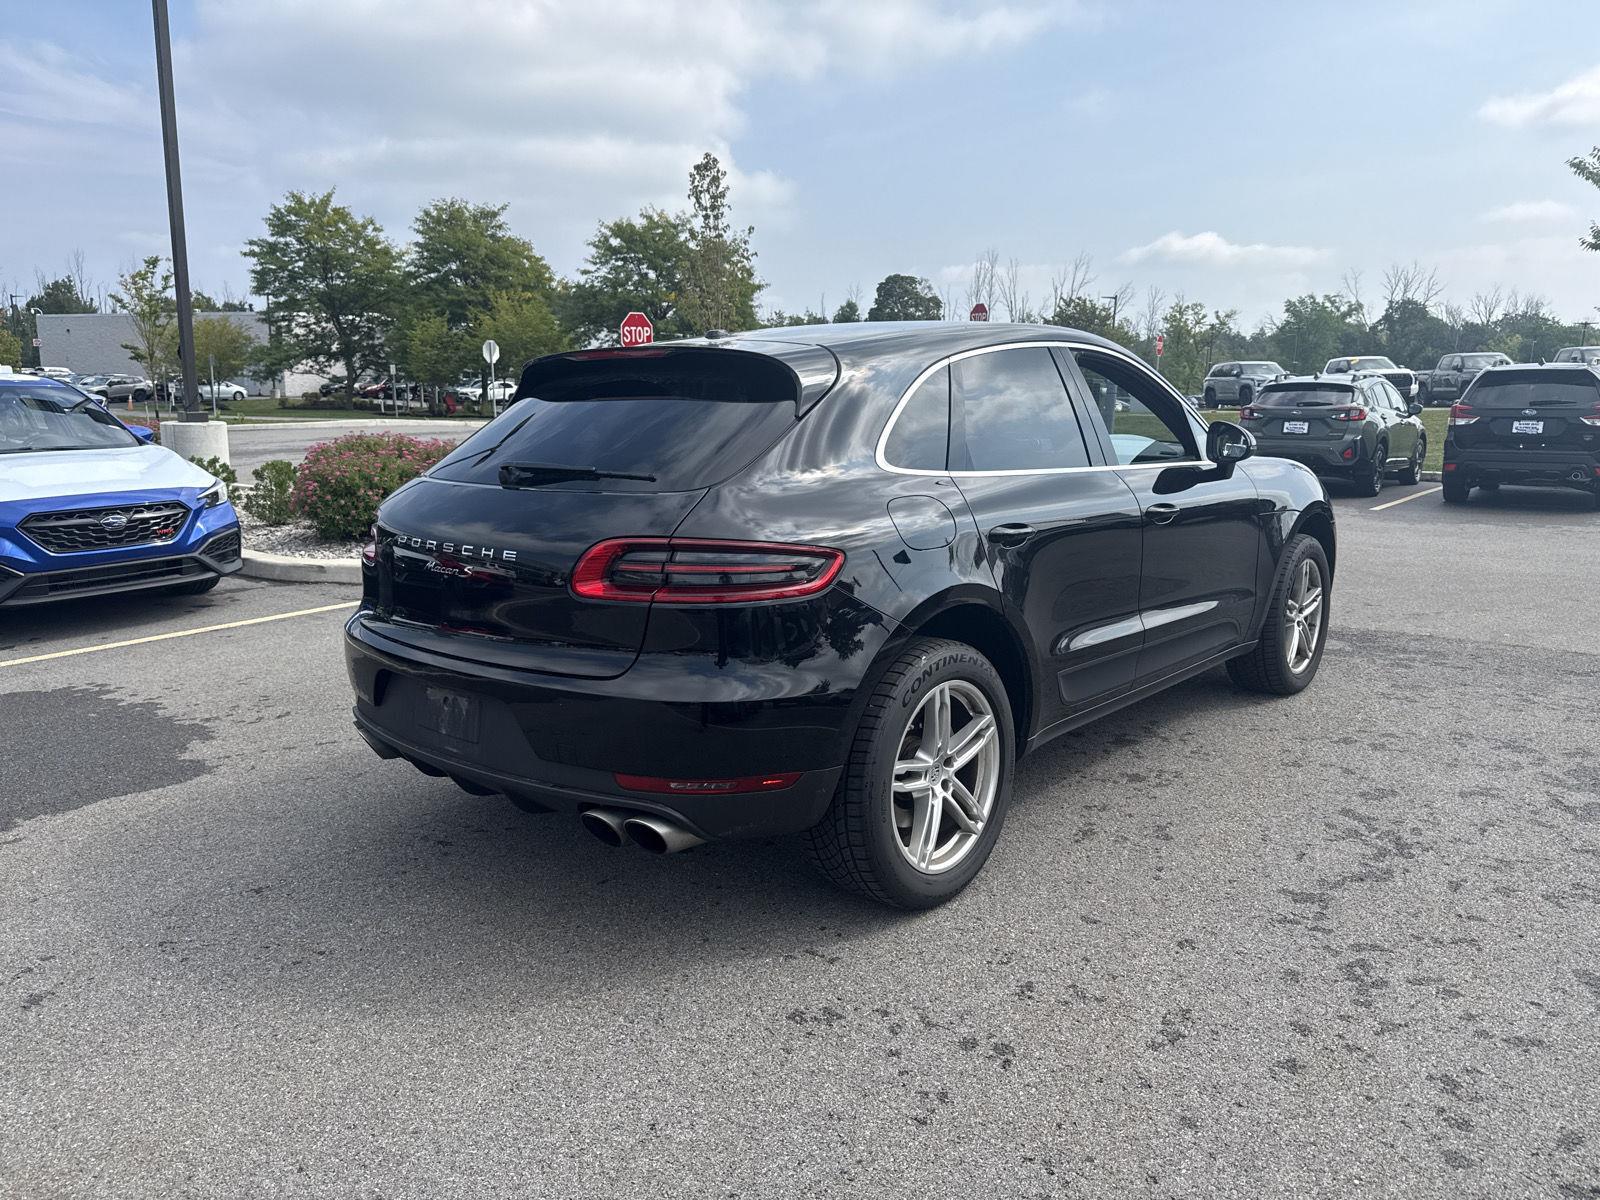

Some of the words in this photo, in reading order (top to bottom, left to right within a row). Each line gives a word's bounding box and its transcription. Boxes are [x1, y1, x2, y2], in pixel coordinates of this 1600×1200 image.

[623, 326, 651, 343] STOP
[398, 535, 517, 561] PORSCHE
[424, 560, 459, 576] Macan
[457, 566, 474, 578] S
